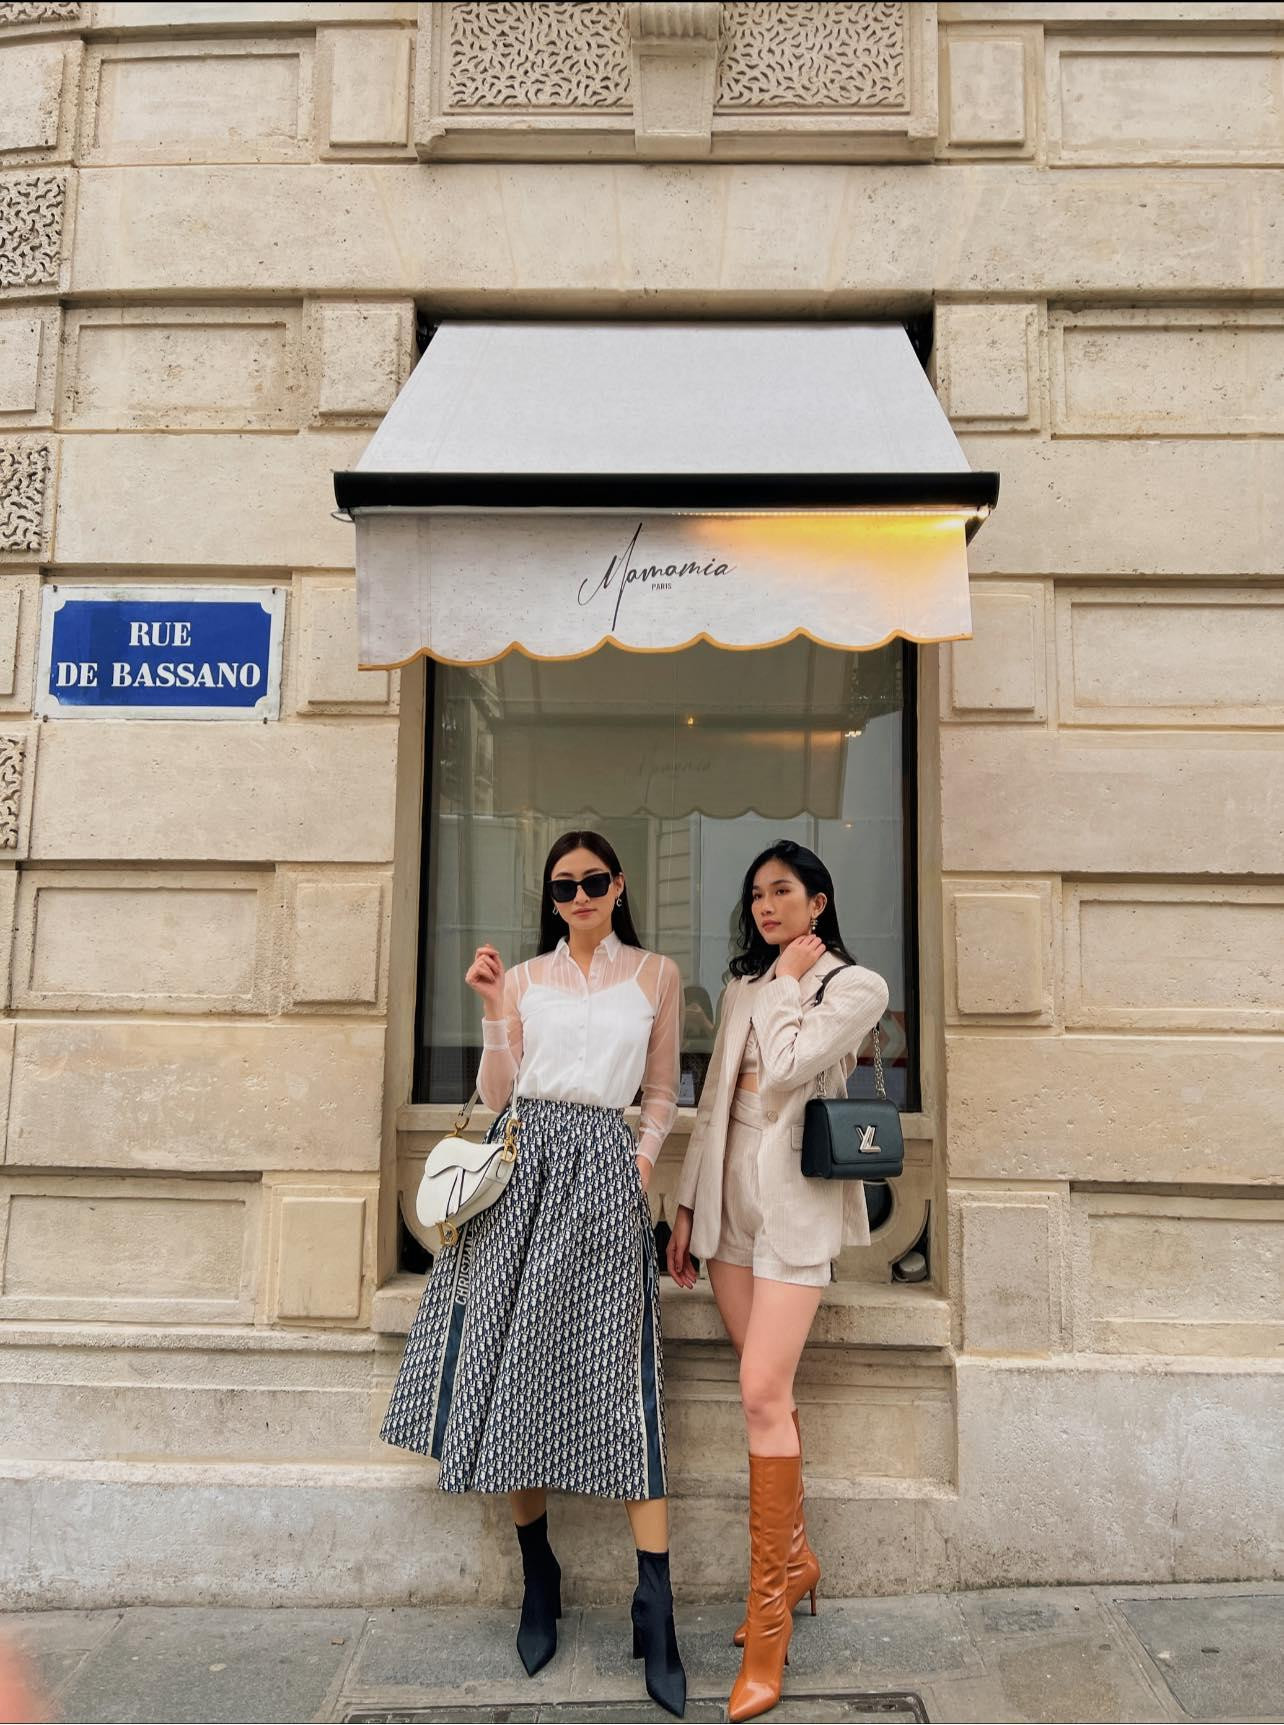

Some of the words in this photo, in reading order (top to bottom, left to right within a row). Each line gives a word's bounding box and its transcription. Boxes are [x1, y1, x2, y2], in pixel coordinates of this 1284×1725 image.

[577, 522, 737, 631] Mamamia
[651, 583, 672, 591] PARIS
[129, 621, 192, 647] RUE
[56, 661, 98, 687] DE
[111, 661, 261, 688] BASSANO
